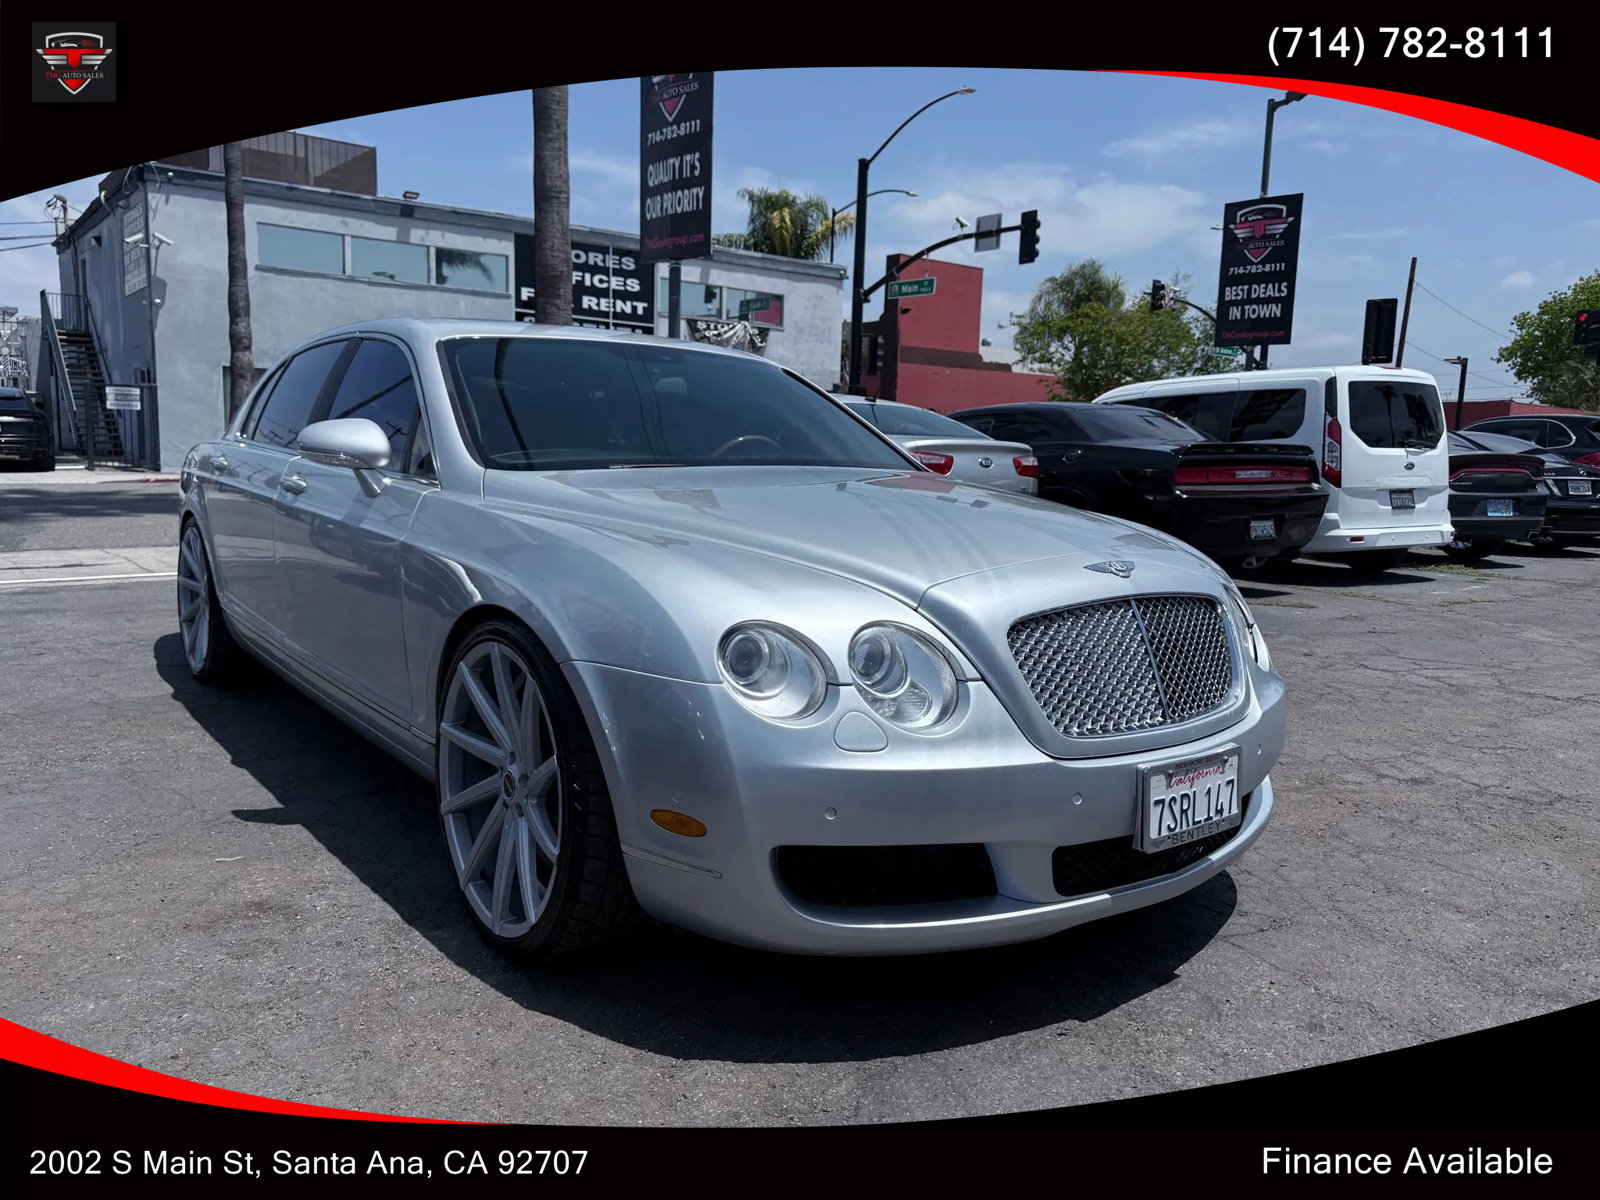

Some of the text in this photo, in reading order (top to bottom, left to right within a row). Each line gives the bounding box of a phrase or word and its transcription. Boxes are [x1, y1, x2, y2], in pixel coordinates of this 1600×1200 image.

[679, 81, 699, 95] SALES
[647, 119, 700, 146] 714-782-8111
[647, 152, 700, 187] QUALITY IT'S
[645, 186, 705, 220] OUR PRIORITY
[1248, 241, 1265, 249] AUTO
[1265, 240, 1285, 248] SALES
[571, 249, 636, 271] ORES
[1228, 262, 1286, 276] 714-782-8111
[572, 271, 641, 292] FICES
[901, 284, 919, 294] Main
[1225, 282, 1288, 301] BEST DEALS
[582, 295, 648, 315] RENT
[1229, 303, 1282, 320] IN TOWN
[1169, 765, 1225, 789] California
[1153, 778, 1235, 836] 7SRL147
[1171, 820, 1221, 845] BENTLEY
